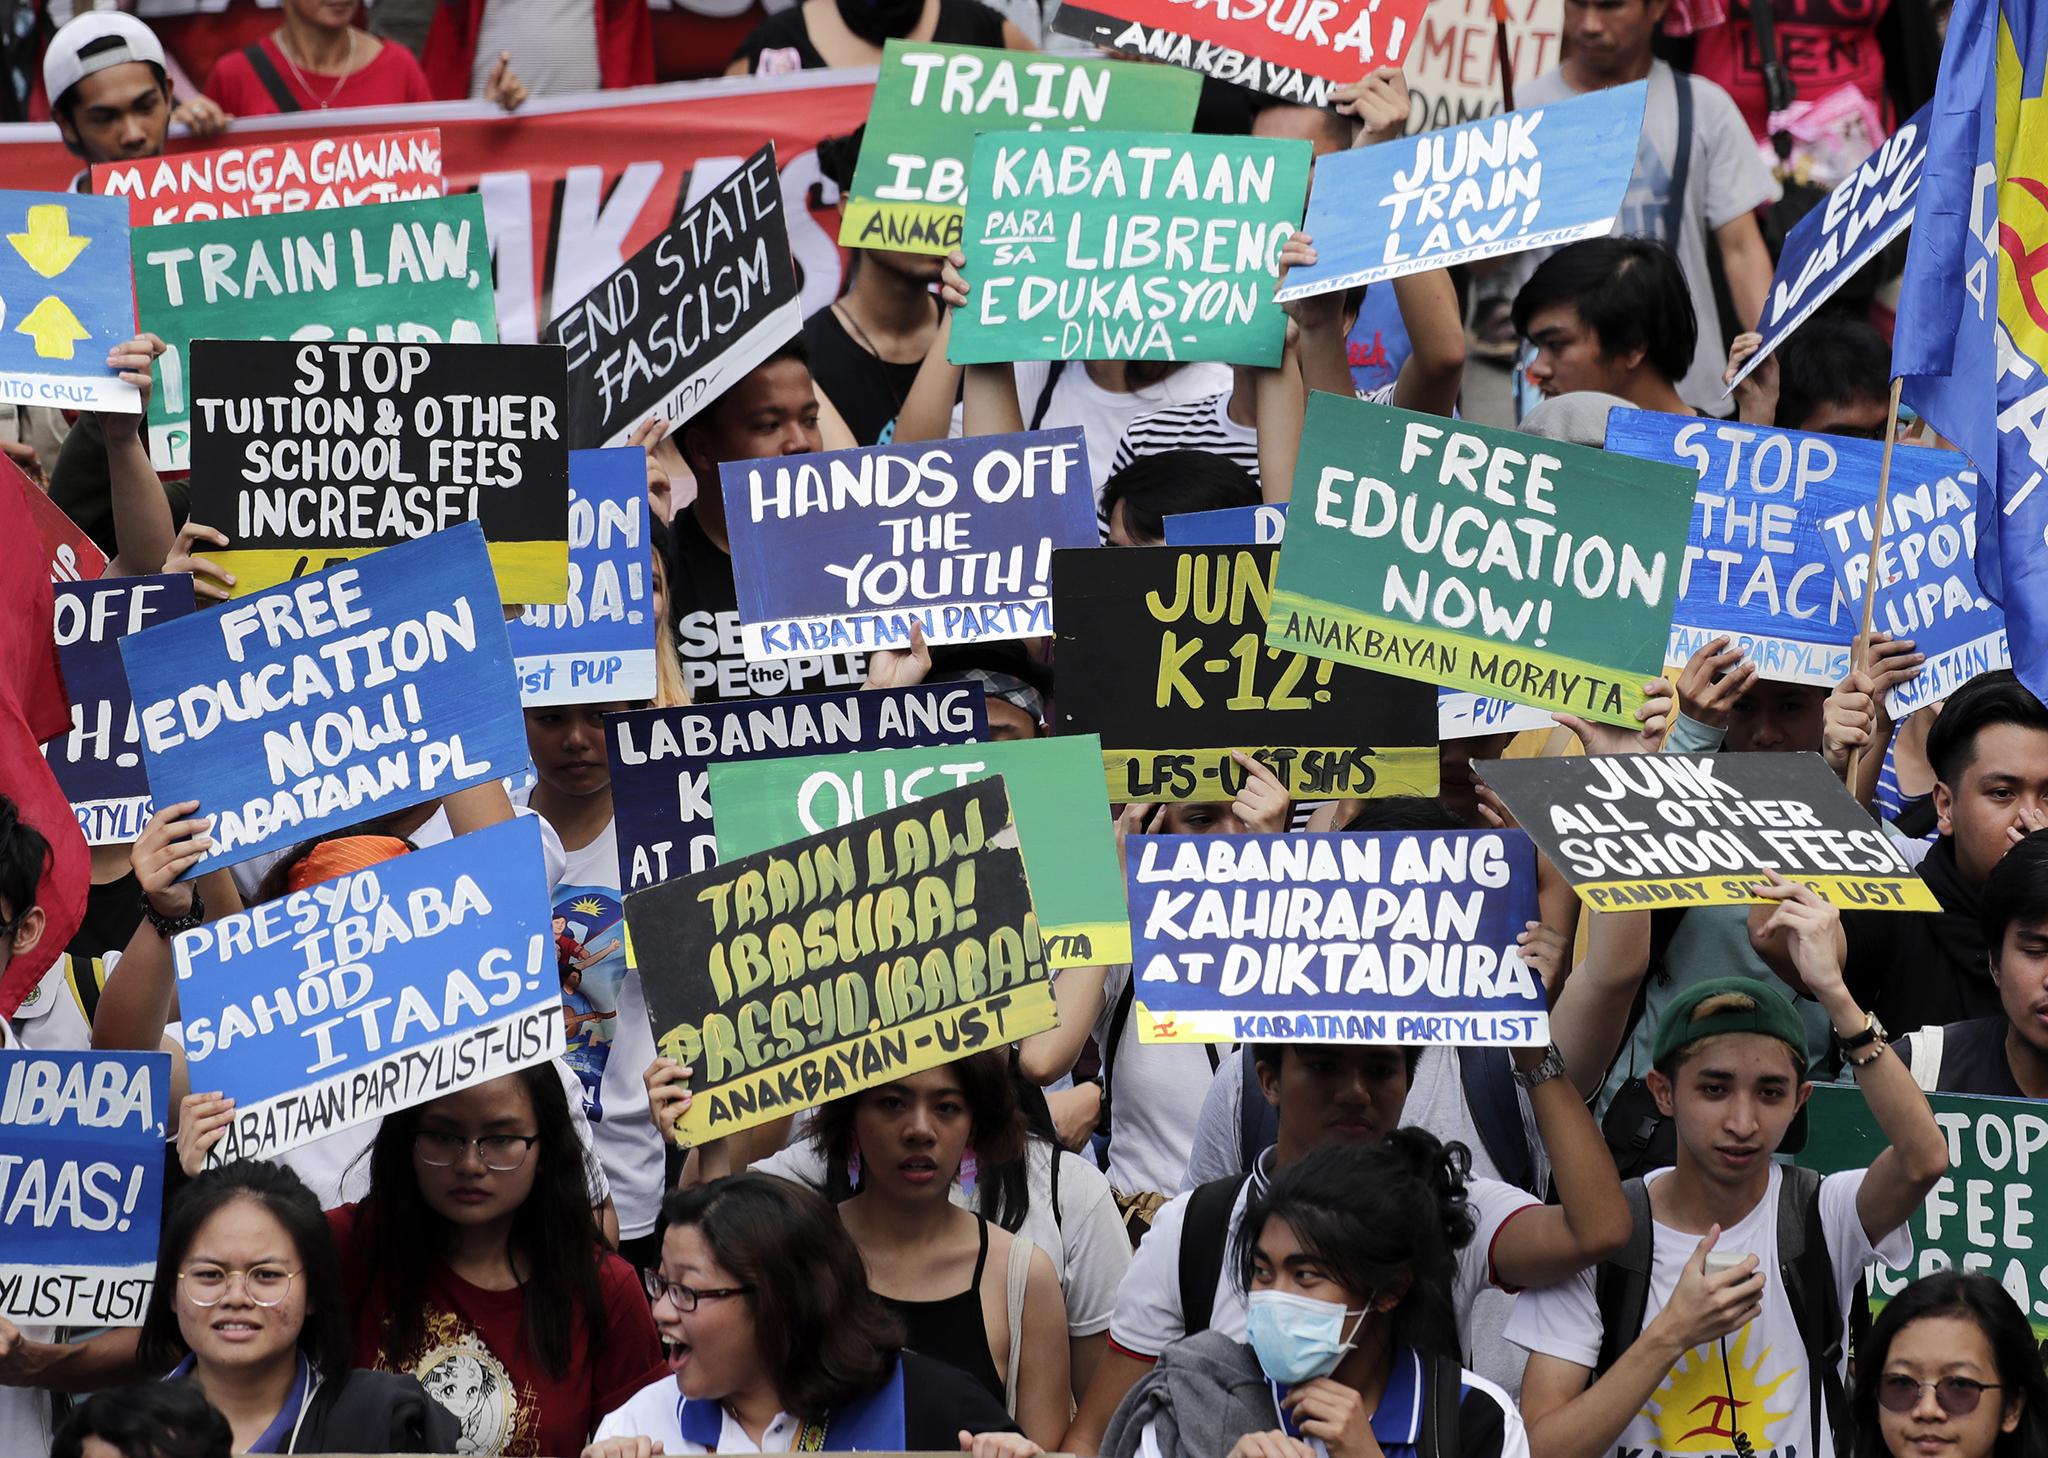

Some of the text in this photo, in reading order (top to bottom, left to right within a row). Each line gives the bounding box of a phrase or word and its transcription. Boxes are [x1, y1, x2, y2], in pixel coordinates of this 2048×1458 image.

[901, 53, 1111, 121] TRAIN
[991, 145, 1275, 204] KABATAAN
[1392, 109, 1545, 194] JUNK
[1821, 123, 1918, 236] END
[984, 210, 1055, 238] PARA
[1378, 161, 1542, 231] TRAIN
[146, 219, 481, 307] TRAIN LAW,
[557, 152, 777, 372] END STATE
[992, 243, 1037, 266] SA
[1065, 211, 1297, 278] LIBRENG
[1382, 199, 1542, 265] LAW!
[1525, 226, 1587, 248] CRUZ
[593, 236, 772, 427] FASCISM
[980, 275, 1258, 326] EDUKASYON
[40, 384, 98, 402] CRUZ
[293, 345, 430, 395] STOP
[196, 395, 560, 441] TUITION & OTHER
[240, 439, 417, 484] SCHOOL
[428, 440, 523, 489] FEES
[748, 443, 1080, 523] HANDS OFF
[1399, 422, 1564, 517] FREE
[1673, 423, 1838, 501] STOP
[878, 512, 973, 557] THE
[1314, 466, 1667, 608] EDUCATION
[1694, 491, 1800, 554] THE
[823, 536, 1053, 608] YOUTH!
[54, 584, 165, 646] OFF
[220, 568, 372, 663] FREE
[760, 608, 934, 655] KABATAAN
[1382, 564, 1555, 649] NOW!
[141, 596, 476, 754] EDUCATION
[571, 656, 623, 688] PUP
[750, 666, 785, 685] the
[1155, 630, 1335, 711] K-12!
[1283, 610, 1624, 716] ANAKBAYAN MORAYTA
[263, 683, 423, 786] NOW!
[616, 689, 975, 766] LABANAN ANG
[418, 734, 492, 792] PL
[1299, 746, 1377, 795] SHS
[1584, 756, 1744, 801] JUNK
[1548, 798, 1824, 836] ALL OTHER
[631, 840, 674, 888] AT
[1135, 834, 1511, 889] LABANAN ANG
[1558, 828, 1911, 878] SCHOOL FEES!
[696, 835, 858, 937] TRAIN
[1142, 887, 1486, 942] KAHIRAPAN
[1586, 881, 1710, 908] PANDAY
[1835, 881, 1907, 906] UST
[292, 874, 493, 981] IBABA
[707, 859, 978, 1007] IBASURA!
[1141, 942, 1538, 1000] AT DIKTADURA
[185, 963, 375, 1062] SAHOD
[300, 933, 545, 1074] ITAAS!
[1233, 1014, 1539, 1042] KABATAAN PARTYLIST
